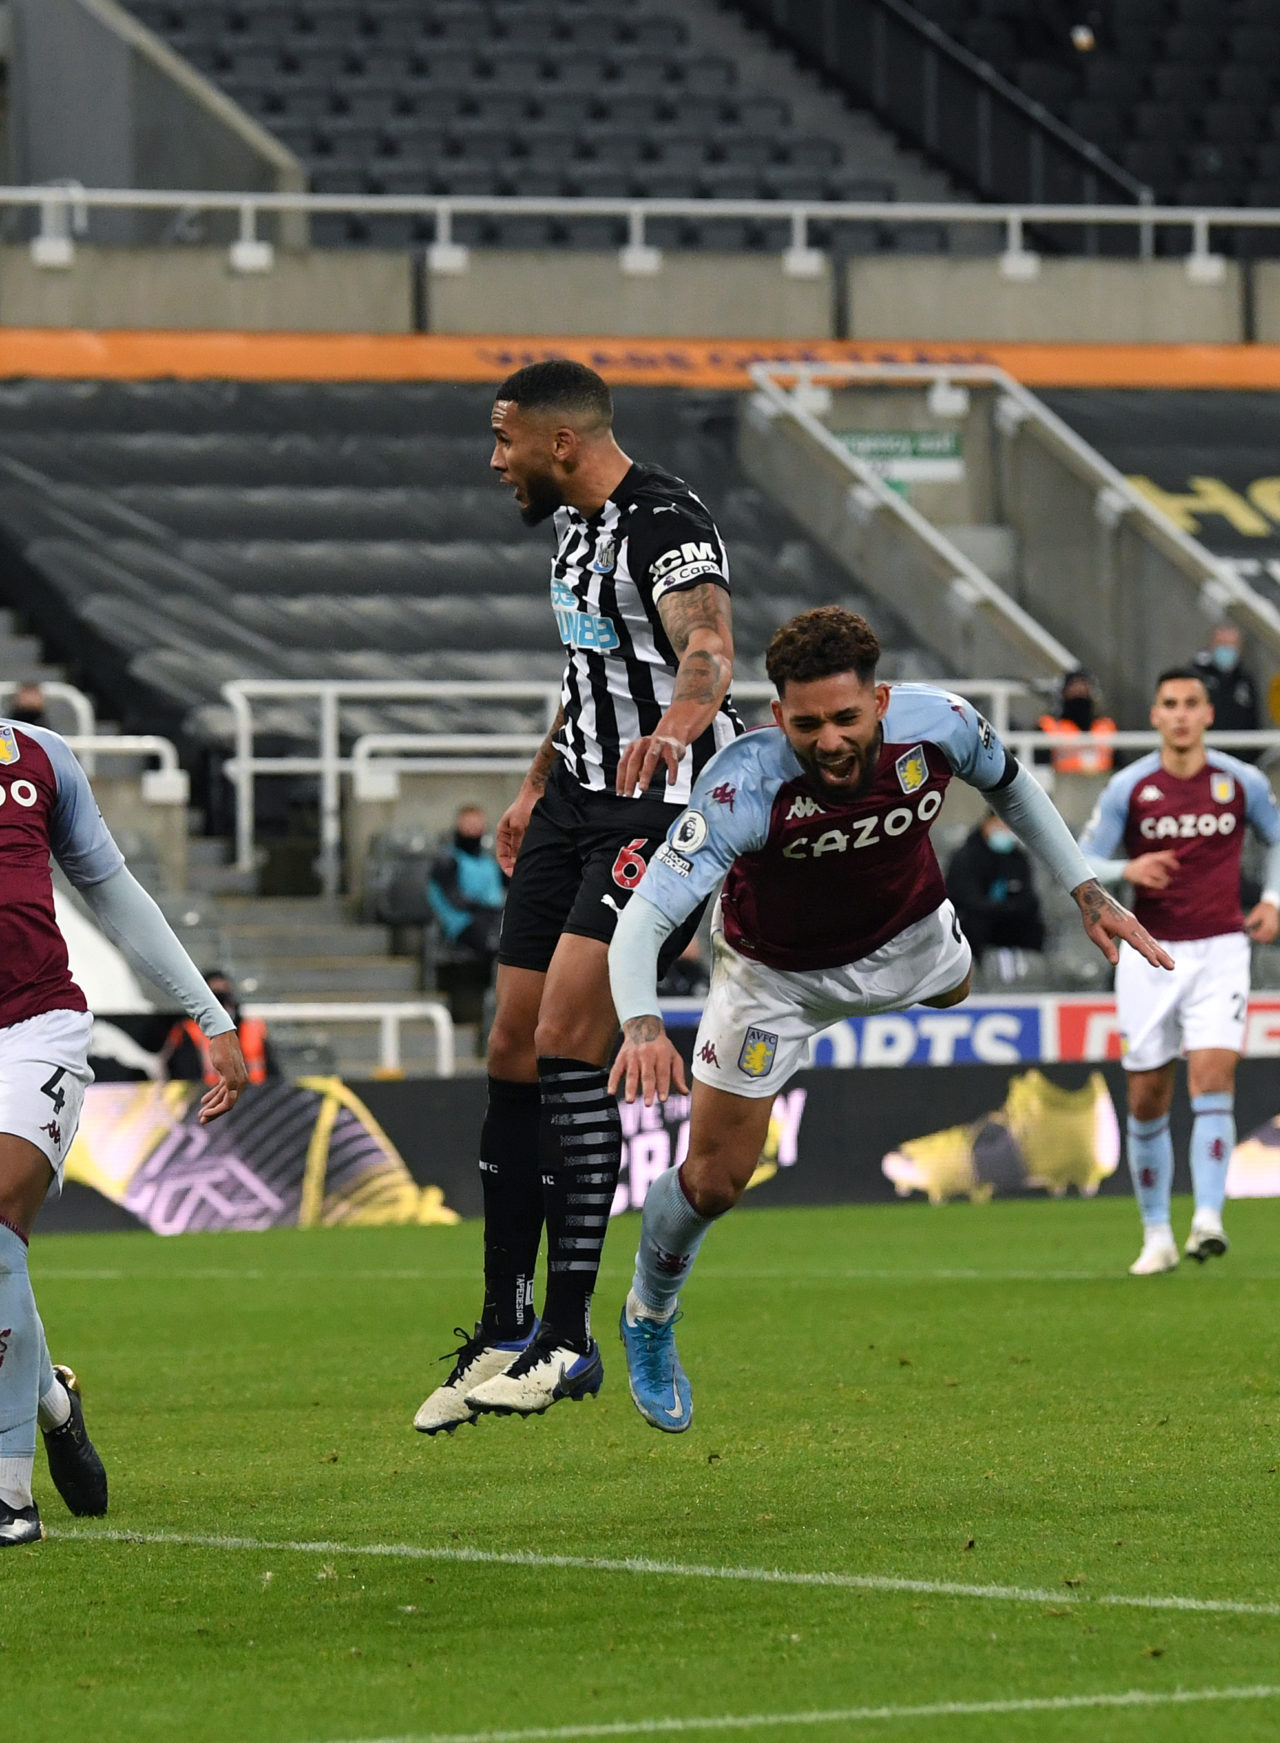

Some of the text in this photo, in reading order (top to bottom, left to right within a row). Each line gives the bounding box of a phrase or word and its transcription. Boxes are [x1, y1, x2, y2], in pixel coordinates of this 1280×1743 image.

[782, 790, 942, 859] CAZOO
[1140, 812, 1237, 840] CAZOO
[611, 838, 648, 889] 6
[809, 1013, 1022, 1067] ORTS
[40, 1066, 66, 1115] 4
